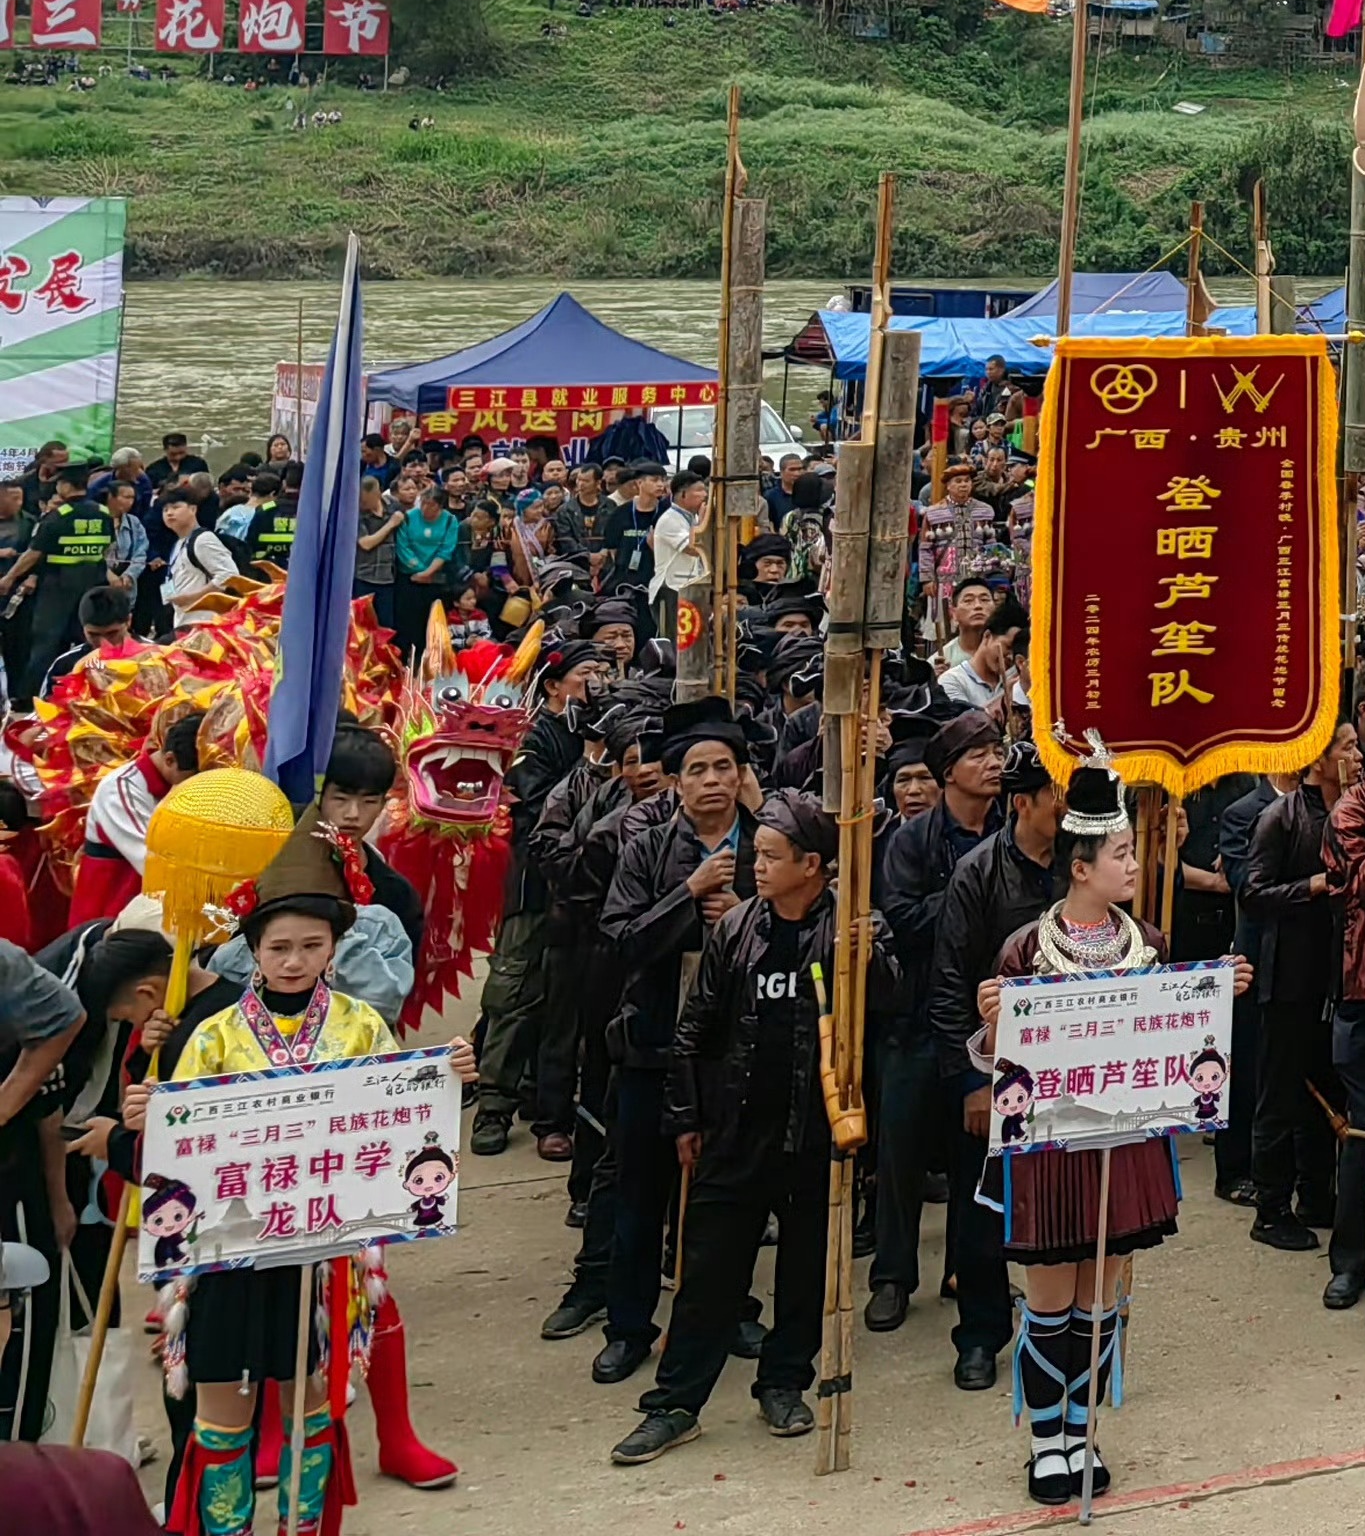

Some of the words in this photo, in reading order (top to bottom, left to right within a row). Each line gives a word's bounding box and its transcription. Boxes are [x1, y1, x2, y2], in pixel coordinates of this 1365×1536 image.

[458, 384, 715, 408] 三江县就业服务中心
[63, 545, 104, 555] POLICE
[1147, 474, 1222, 707] 登晒芦笙队
[1033, 990, 1139, 1011] 广西三江农村商业银行
[1019, 1009, 1212, 1046] 富禄“三月三”民族花炮节
[1033, 1052, 1191, 1101] 登晒芦笙队
[193, 1088, 335, 1117] 广西三江农村商业银行
[174, 1104, 433, 1159] 富禄“三月三”民族花炮节
[213, 1140, 393, 1202] 富禄中学
[256, 1193, 346, 1241] 龙队
